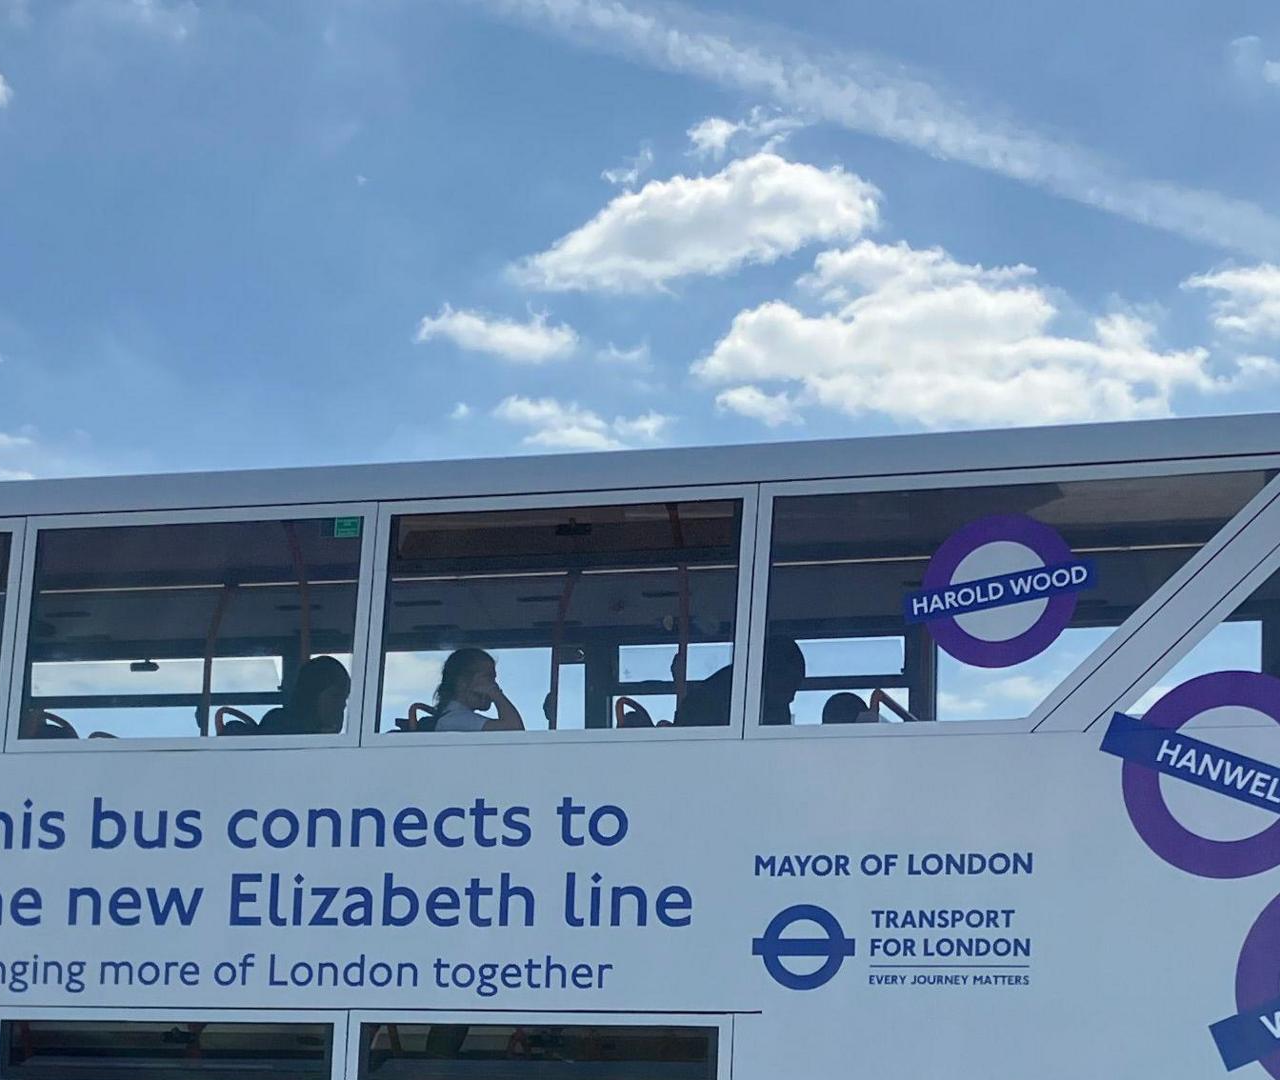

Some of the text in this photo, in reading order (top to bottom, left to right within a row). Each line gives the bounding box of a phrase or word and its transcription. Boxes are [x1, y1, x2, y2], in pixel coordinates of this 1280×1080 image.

[911, 565, 1087, 616] HAROLD WOOD
[93, 797, 202, 849] bus
[227, 798, 531, 848] connects
[557, 797, 628, 846] to
[755, 853, 1032, 876] MAYOR OF LONDON
[69, 887, 202, 926] new
[230, 873, 534, 927] Elizabeth
[566, 873, 692, 927] line
[872, 910, 1015, 928] TRANSPORT
[870, 938, 1030, 957] FOR LONDON
[100, 962, 199, 985] more
[215, 954, 254, 986] of
[269, 954, 417, 988] London
[434, 957, 612, 996] together
[869, 975, 1029, 985] EVERY JOURNEY MATTERS
